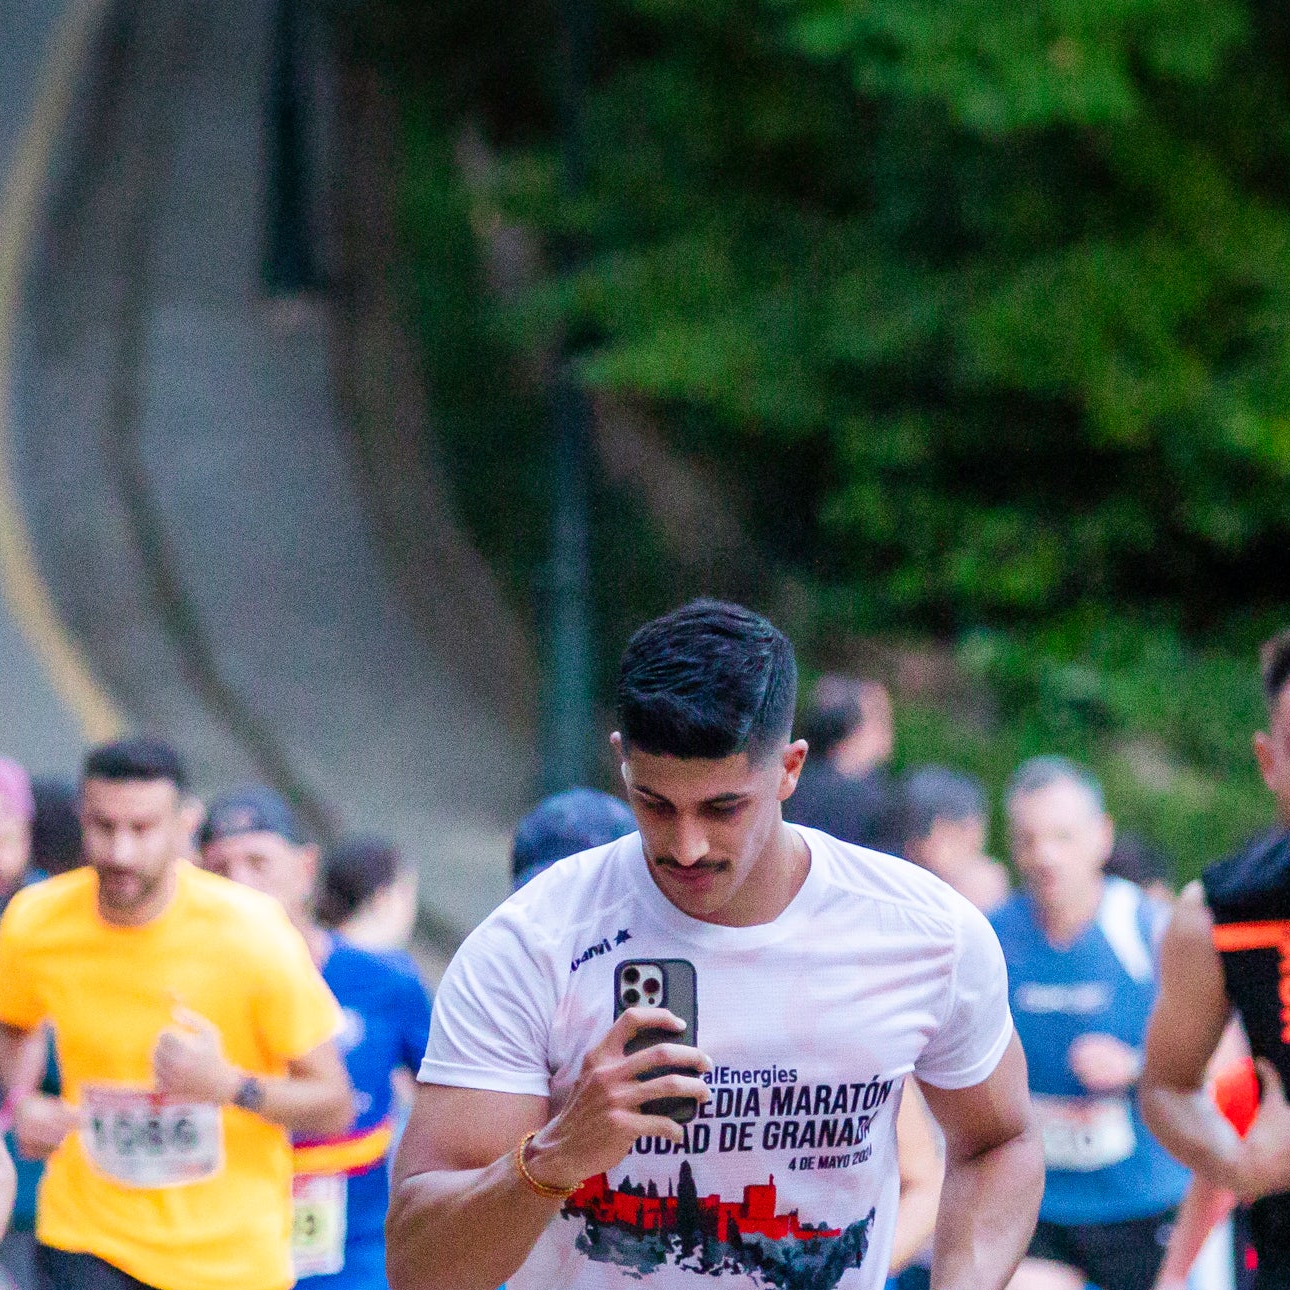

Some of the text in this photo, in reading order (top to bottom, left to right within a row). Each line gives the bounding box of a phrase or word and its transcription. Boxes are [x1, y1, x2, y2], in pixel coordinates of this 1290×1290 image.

[570, 938, 612, 973] uanvi
[703, 1065, 798, 1088] alEnergies
[698, 1074, 894, 1118] EDIA MARATÓN
[628, 1123, 710, 1154] UDAD
[719, 1122, 756, 1152] DE
[788, 1160, 797, 1171] 4
[800, 1157, 814, 1170] DE
[817, 1154, 850, 1169] MAYO
